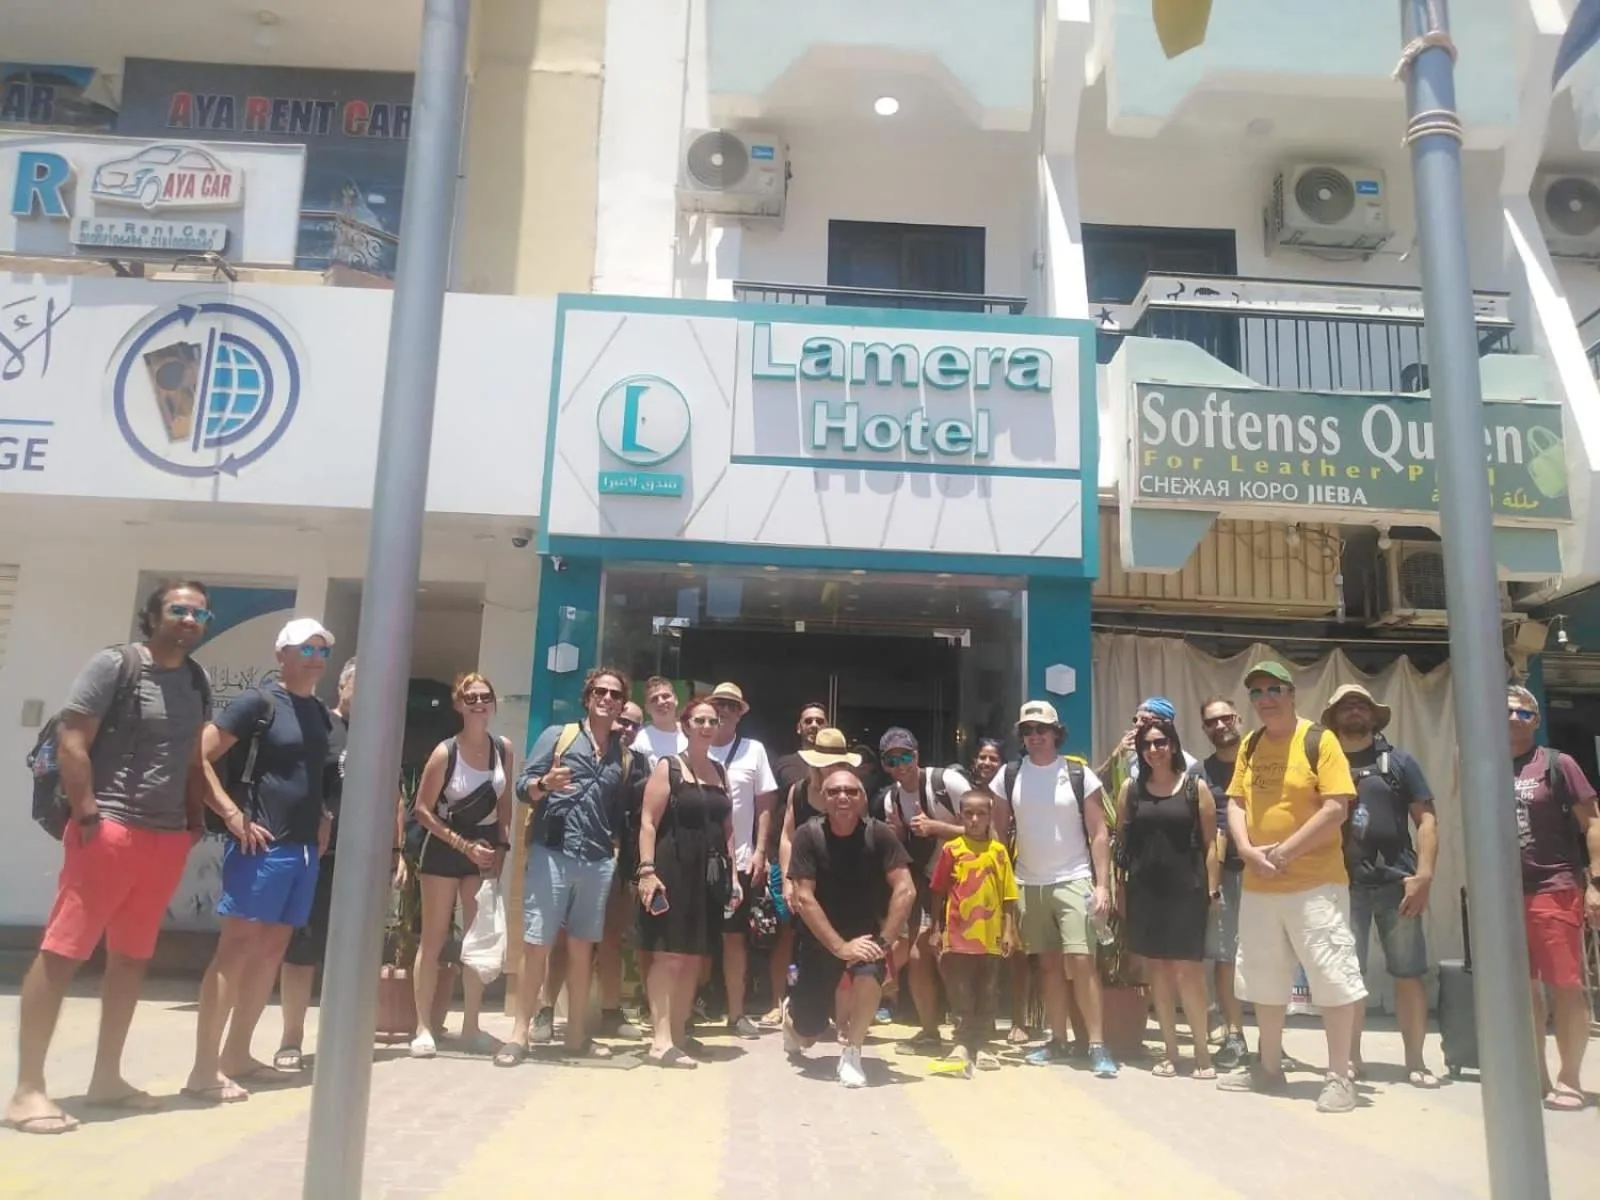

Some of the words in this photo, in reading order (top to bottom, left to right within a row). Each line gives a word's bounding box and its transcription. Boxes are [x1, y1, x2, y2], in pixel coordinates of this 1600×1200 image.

[166, 92, 236, 129] AYA
[244, 96, 338, 135] RENT
[11, 151, 74, 219] R
[163, 173, 196, 198] AYA
[201, 174, 232, 198] CAR
[752, 322, 1053, 393] Lamera
[811, 401, 991, 459] Hotel
[1141, 391, 1341, 456] Softenss
[1361, 403, 1524, 474] Qun
[1139, 475, 1230, 497] СНЕЖАЯ
[1144, 450, 1204, 471] For
[1231, 455, 1383, 481] Leather
